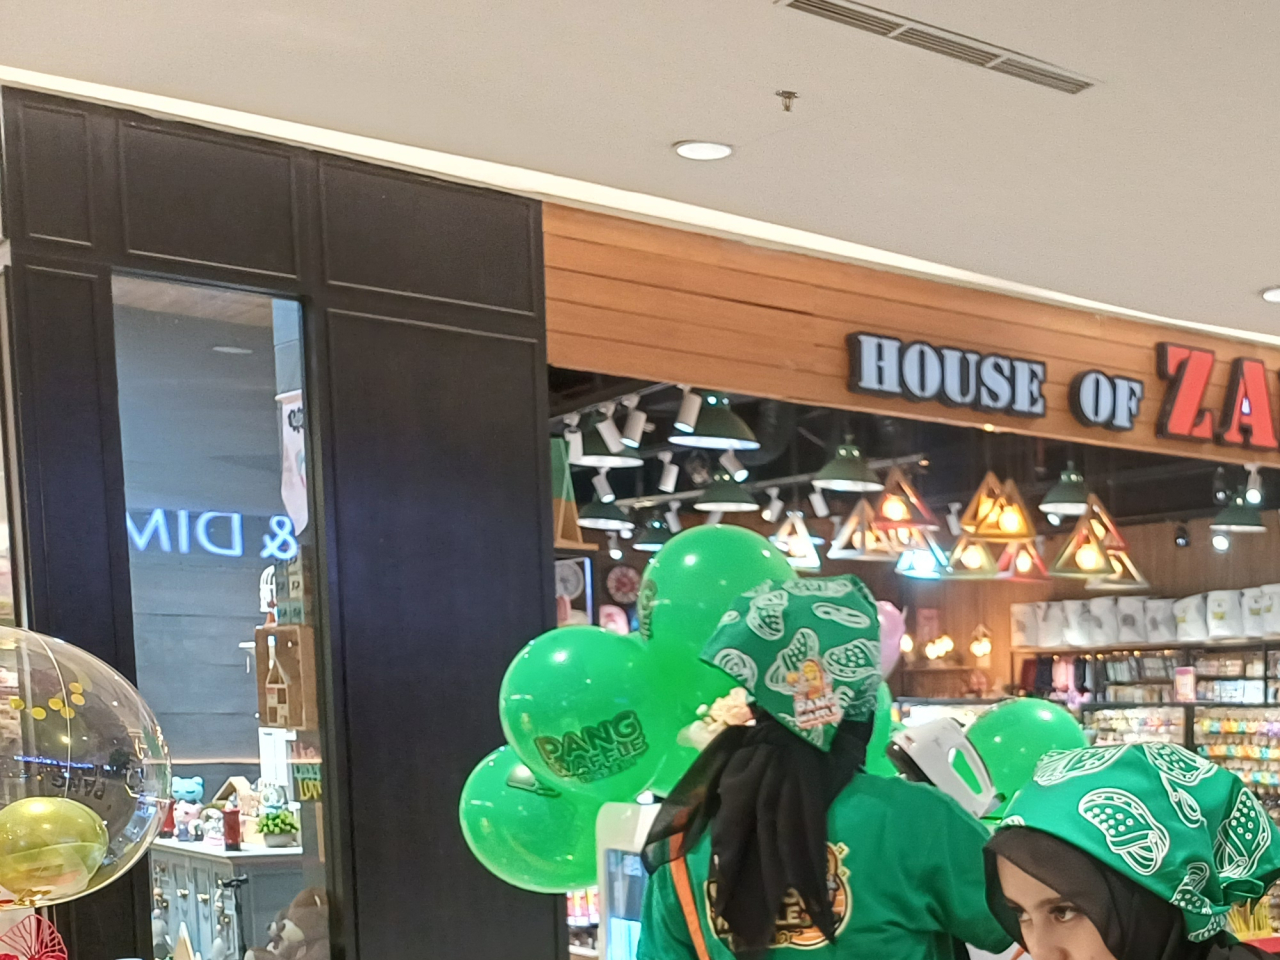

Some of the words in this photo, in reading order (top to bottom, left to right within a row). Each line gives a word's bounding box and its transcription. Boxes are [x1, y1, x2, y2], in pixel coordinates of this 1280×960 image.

[853, 333, 1045, 416] HOUSE
[1075, 371, 1143, 430] OF
[534, 709, 642, 760] PANG
